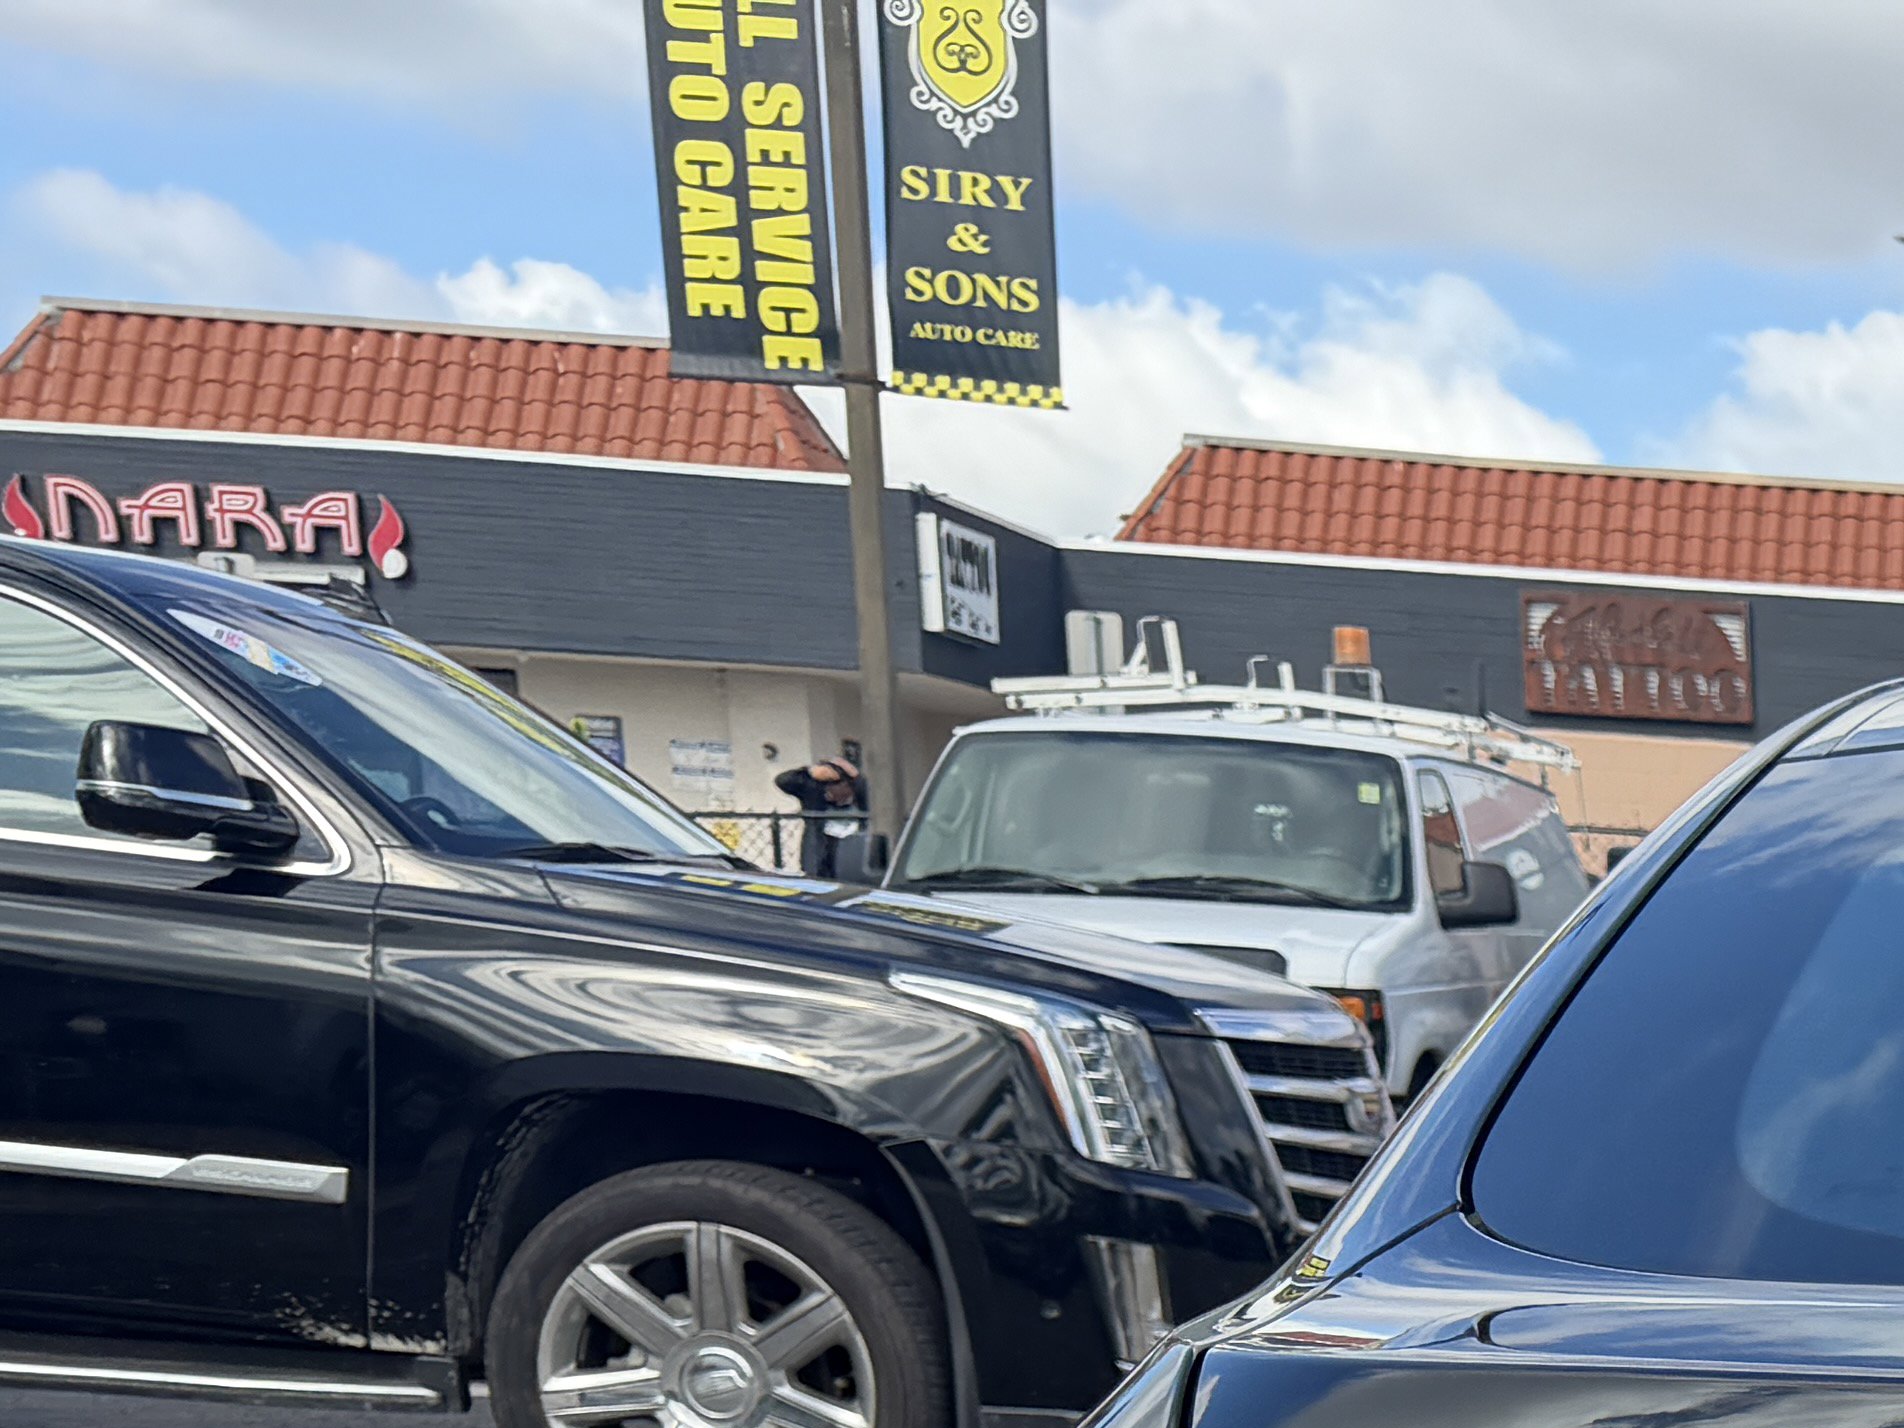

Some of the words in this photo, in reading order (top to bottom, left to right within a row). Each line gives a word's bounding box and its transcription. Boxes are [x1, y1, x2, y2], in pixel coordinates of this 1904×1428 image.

[662, 0, 731, 122] UTO
[900, 166, 1033, 211] SIRY
[673, 139, 746, 319] CARE
[742, 81, 824, 371] SERVICE
[946, 223, 991, 254] &
[904, 267, 1039, 313] SONS
[910, 321, 972, 343] AUTO
[975, 327, 1040, 350] CARE
